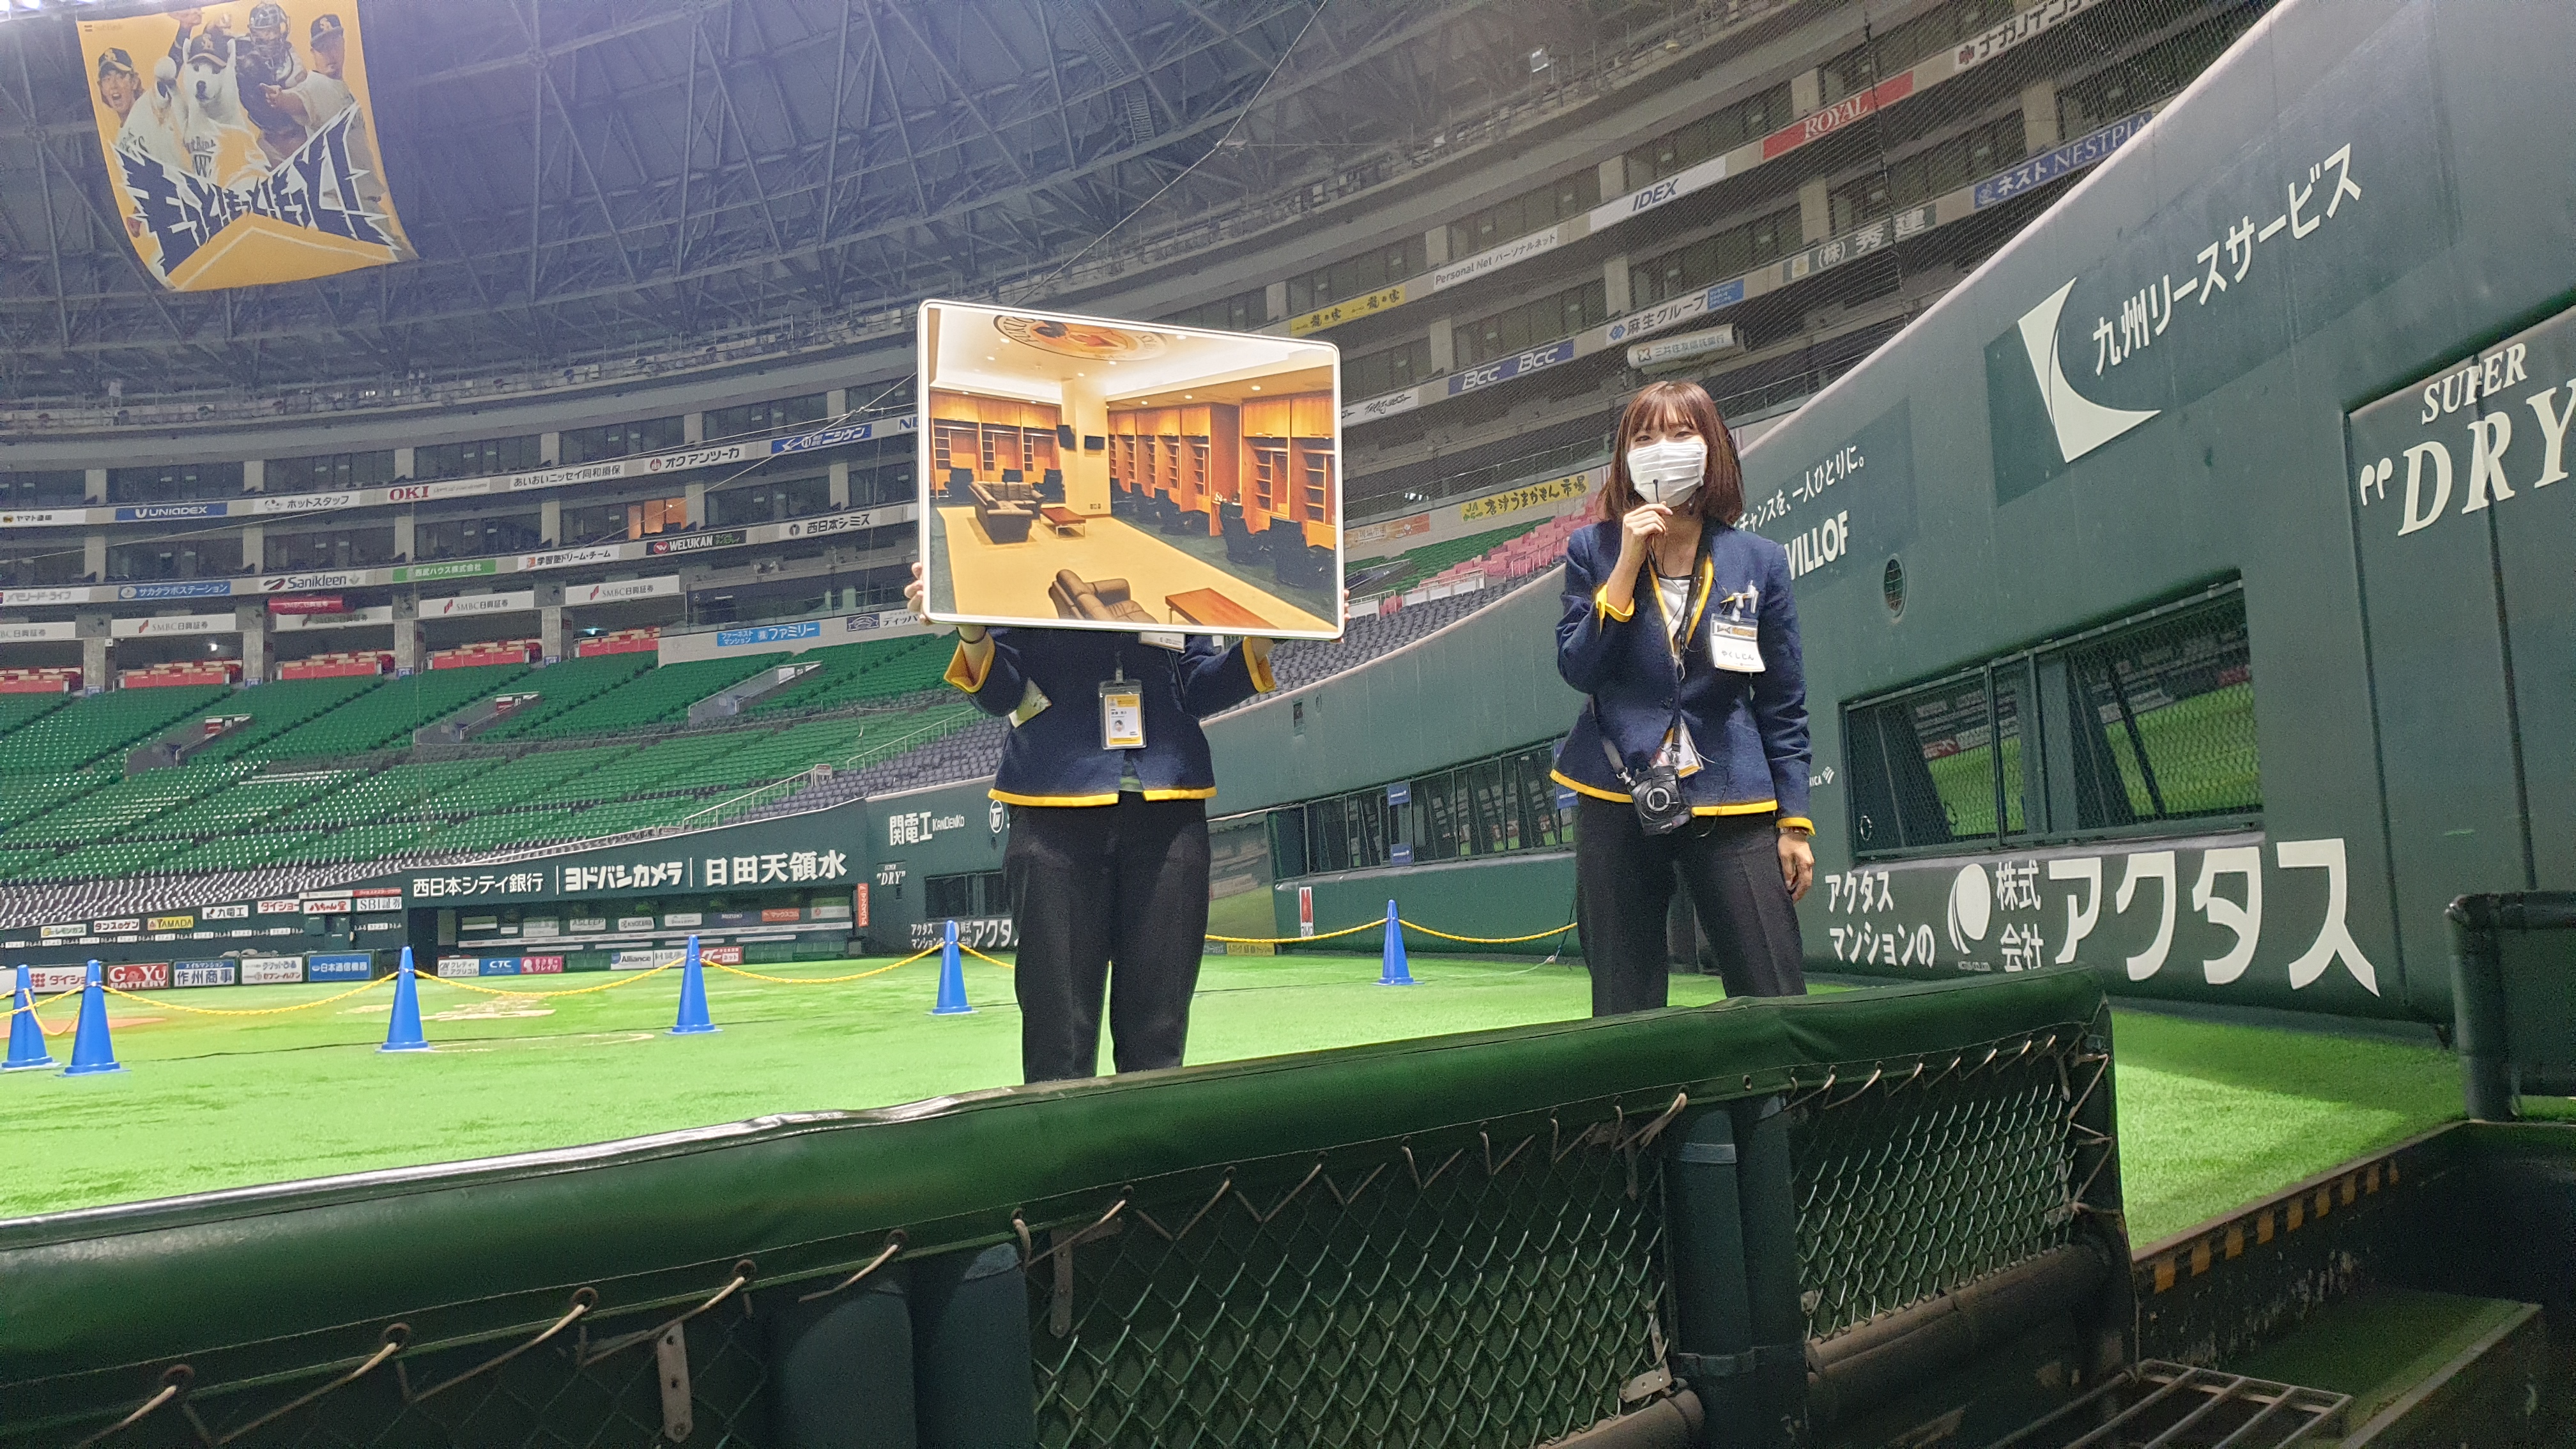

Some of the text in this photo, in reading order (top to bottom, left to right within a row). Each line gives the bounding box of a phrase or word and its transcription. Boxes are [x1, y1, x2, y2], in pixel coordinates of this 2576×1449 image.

[1804, 96, 1869, 139] ROYAL
[1998, 162, 2046, 195] ネスト
[1632, 178, 1679, 211] IDEX
[2093, 142, 2362, 376] 九州リースサービス
[1435, 263, 1475, 286] Personal
[1627, 293, 1706, 336] 麻生グループ
[2422, 343, 2527, 425] SUPER
[666, 447, 740, 469] オクアンツーカ
[514, 464, 622, 487] あいおいニッセイ同和損保
[1734, 445, 1865, 532] チャンスを、一人ひとりに。
[288, 494, 349, 509] ホットスタッフ
[389, 486, 430, 502] OKI
[149, 505, 208, 516] UNIADEX
[669, 535, 714, 552] WELUKAN
[288, 574, 347, 588] Sanikleen
[889, 811, 933, 846] 関電工
[565, 862, 684, 892] ヨドバシカメラ
[706, 848, 848, 887] 日田天領水
[413, 872, 544, 898] 西日本シティ銀行
[1825, 870, 1894, 914] アクタス
[1995, 859, 2042, 912] 株式
[217, 907, 245, 918] 九電工
[360, 898, 401, 910] SBI証券
[157, 918, 192, 928] YAMADA
[910, 923, 933, 936] アクタス
[2048, 838, 2381, 999] アクタス
[972, 919, 1019, 949] アクタ
[1829, 921, 1935, 969] マンションの
[621, 954, 652, 963] Alliance
[1999, 923, 2044, 974] 会社
[177, 969, 232, 985] 作州商事
[489, 960, 512, 969] CTC
[49, 975, 86, 986] ダイショ
